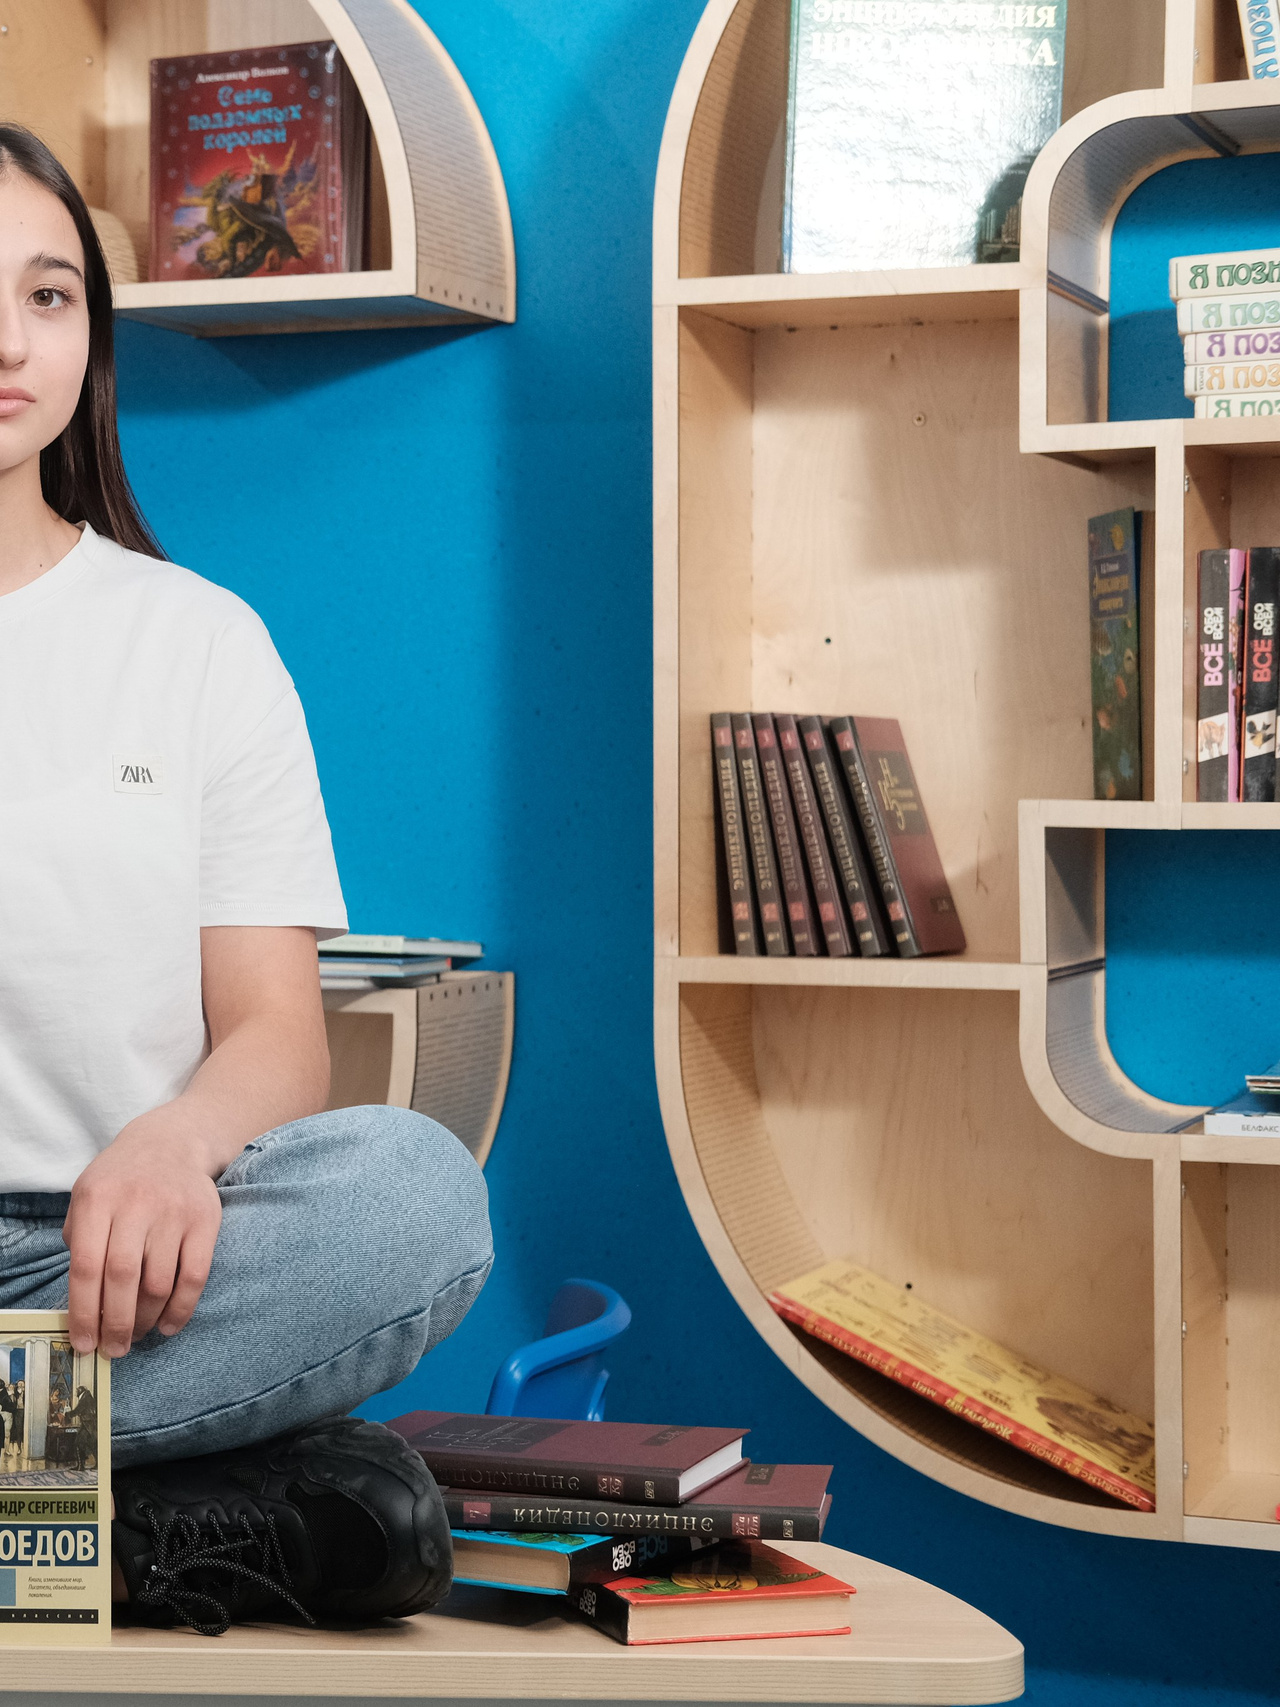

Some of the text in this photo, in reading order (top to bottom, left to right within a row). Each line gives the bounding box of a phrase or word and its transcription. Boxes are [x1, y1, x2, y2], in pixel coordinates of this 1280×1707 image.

[811, 32, 1057, 66] ШКОКА
[1252, 58, 1279, 80] Я
[203, 125, 286, 153] королей
[1189, 264, 1209, 289] Я
[1202, 300, 1280, 328] Я ПОЗ
[1207, 333, 1226, 358] Я
[1206, 366, 1225, 390] Я
[1213, 399, 1232, 418] Я
[1203, 607, 1214, 635] ОБО
[1212, 606, 1224, 640] ВСЕМ
[1253, 603, 1263, 630] ОБО
[1262, 603, 1274, 636] ВСЕМ
[121, 765, 155, 783] ZARA
[719, 758, 745, 891] ЭНЦИКЛОПЕДИЯ
[741, 758, 772, 891] ЭНЦИКЛОПЕДИЯ
[1241, 1124, 1280, 1133] БЕЛФАКС
[1073, 1465, 1142, 1506] ГОТОВИМСЯ
[28, 1501, 96, 1515] СЕРГЕЕВИЧ
[512, 1507, 715, 1534] ЭНЦИКЛОПЕДИЯ
[612, 1540, 635, 1559] ВСЕМ
[613, 1555, 632, 1572] ОБО
[579, 1596, 596, 1618] ВСЕМ
[583, 1588, 597, 1604] ОБО
[11, 1612, 96, 1620] классика
